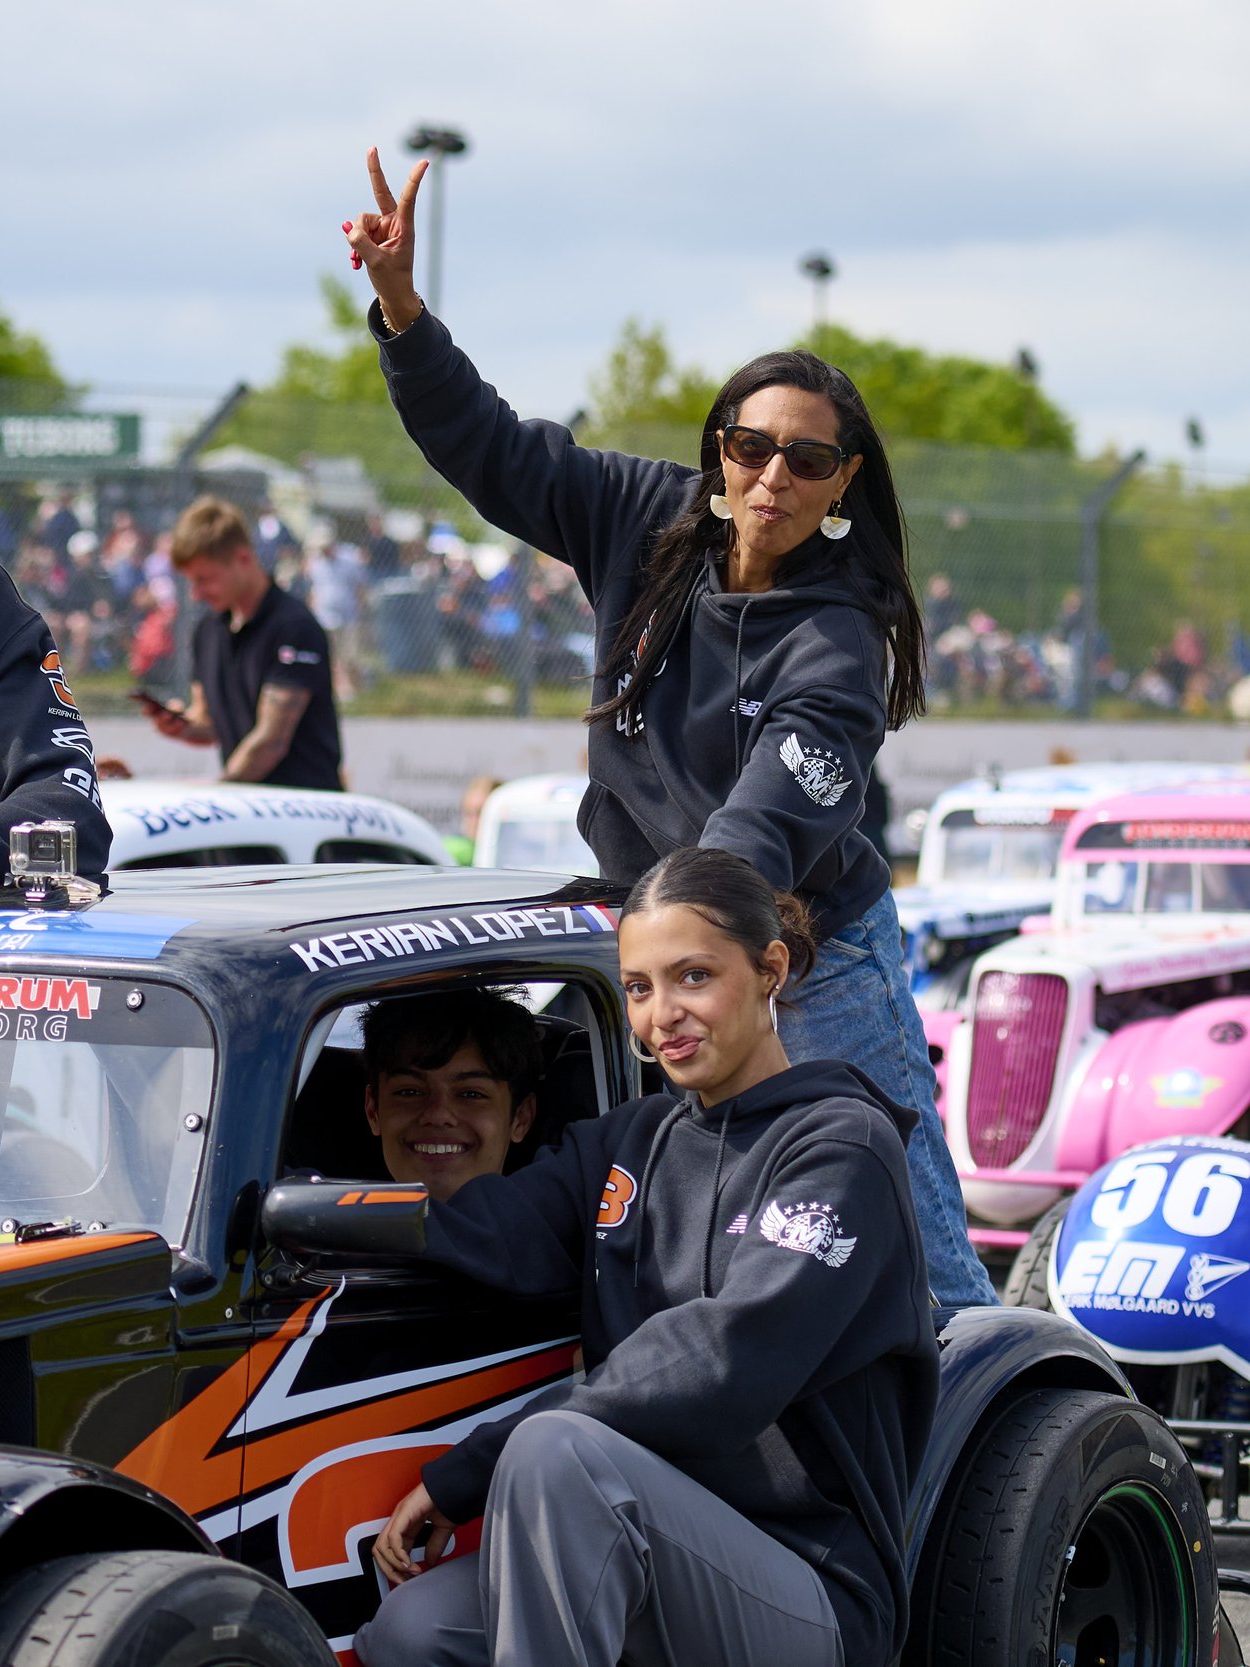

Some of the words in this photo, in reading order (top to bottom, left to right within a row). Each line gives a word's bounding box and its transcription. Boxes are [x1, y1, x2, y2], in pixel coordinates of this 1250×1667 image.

[127, 799, 238, 837] Beck
[242, 797, 405, 837] Transport
[289, 919, 460, 973] KERIAN
[449, 906, 591, 945] LOPEZ
[1090, 1150, 1250, 1237] 56
[777, 1238, 825, 1261] RACING
[1181, 1301, 1216, 1319] VVS
